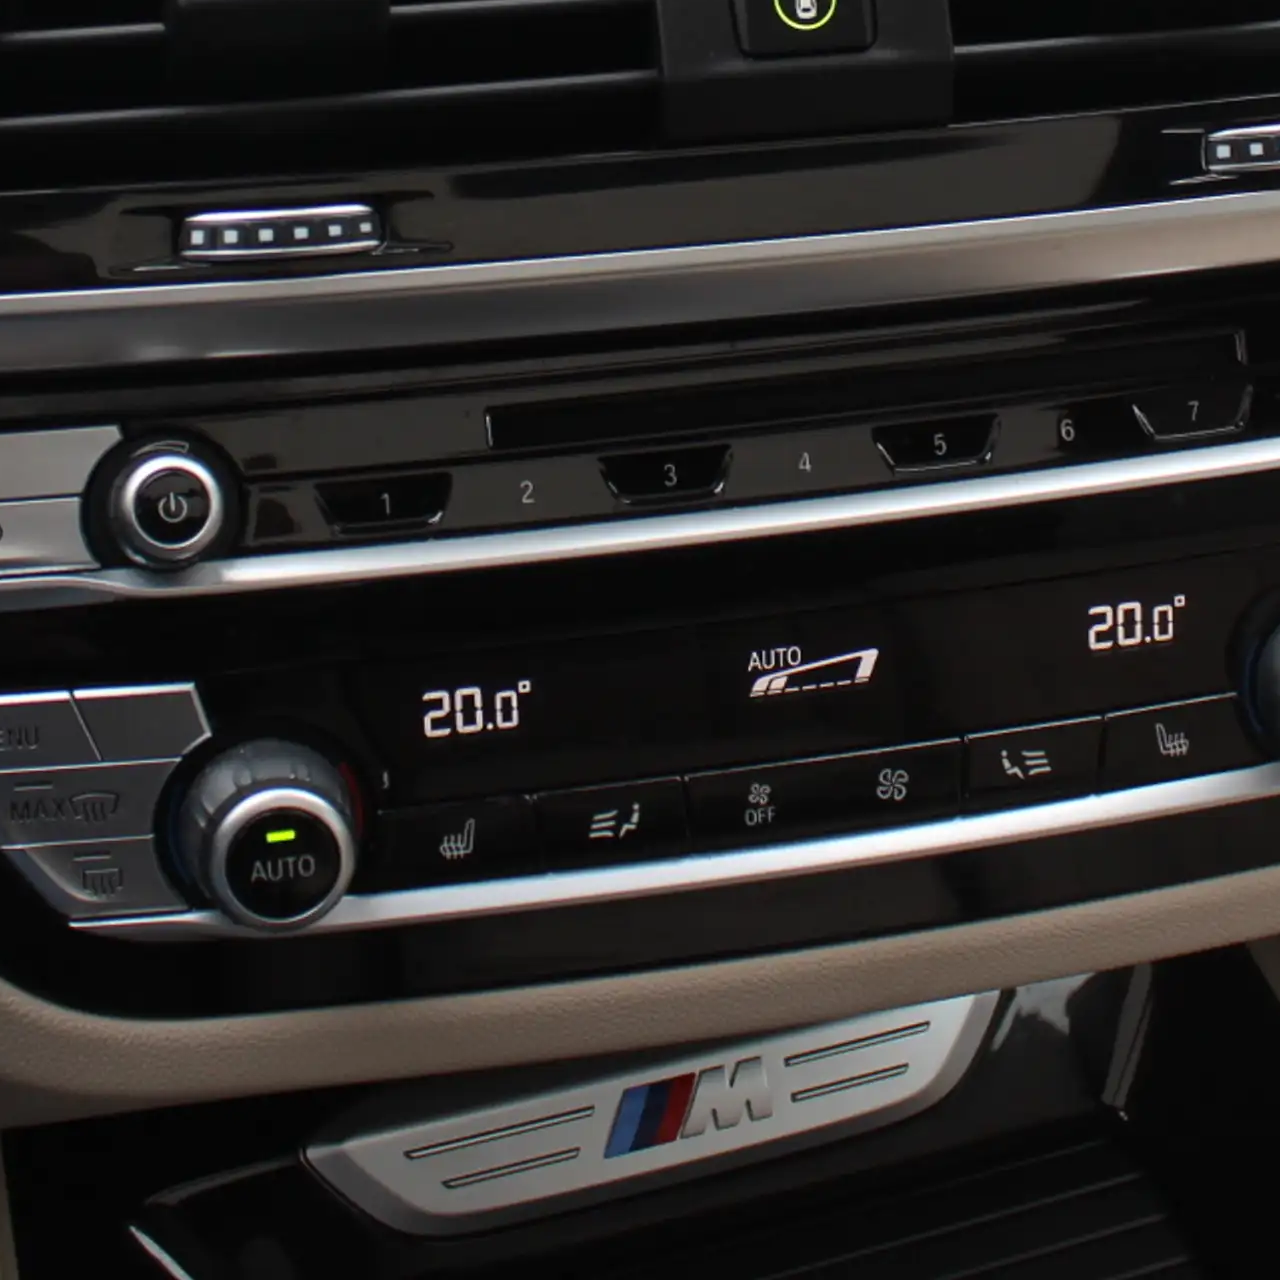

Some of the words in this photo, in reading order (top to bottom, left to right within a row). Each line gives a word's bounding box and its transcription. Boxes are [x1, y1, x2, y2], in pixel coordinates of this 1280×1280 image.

[1186, 400, 1200, 422] 7
[1060, 419, 1075, 442] 6
[933, 433, 947, 456] 5
[797, 451, 813, 474] 4
[663, 464, 678, 487] 3
[380, 492, 392, 516] 1
[520, 481, 536, 504] 2
[747, 645, 803, 672] AUTO
[10, 798, 67, 824] MAX
[744, 805, 776, 826] OFF
[250, 853, 317, 884] AUTO
